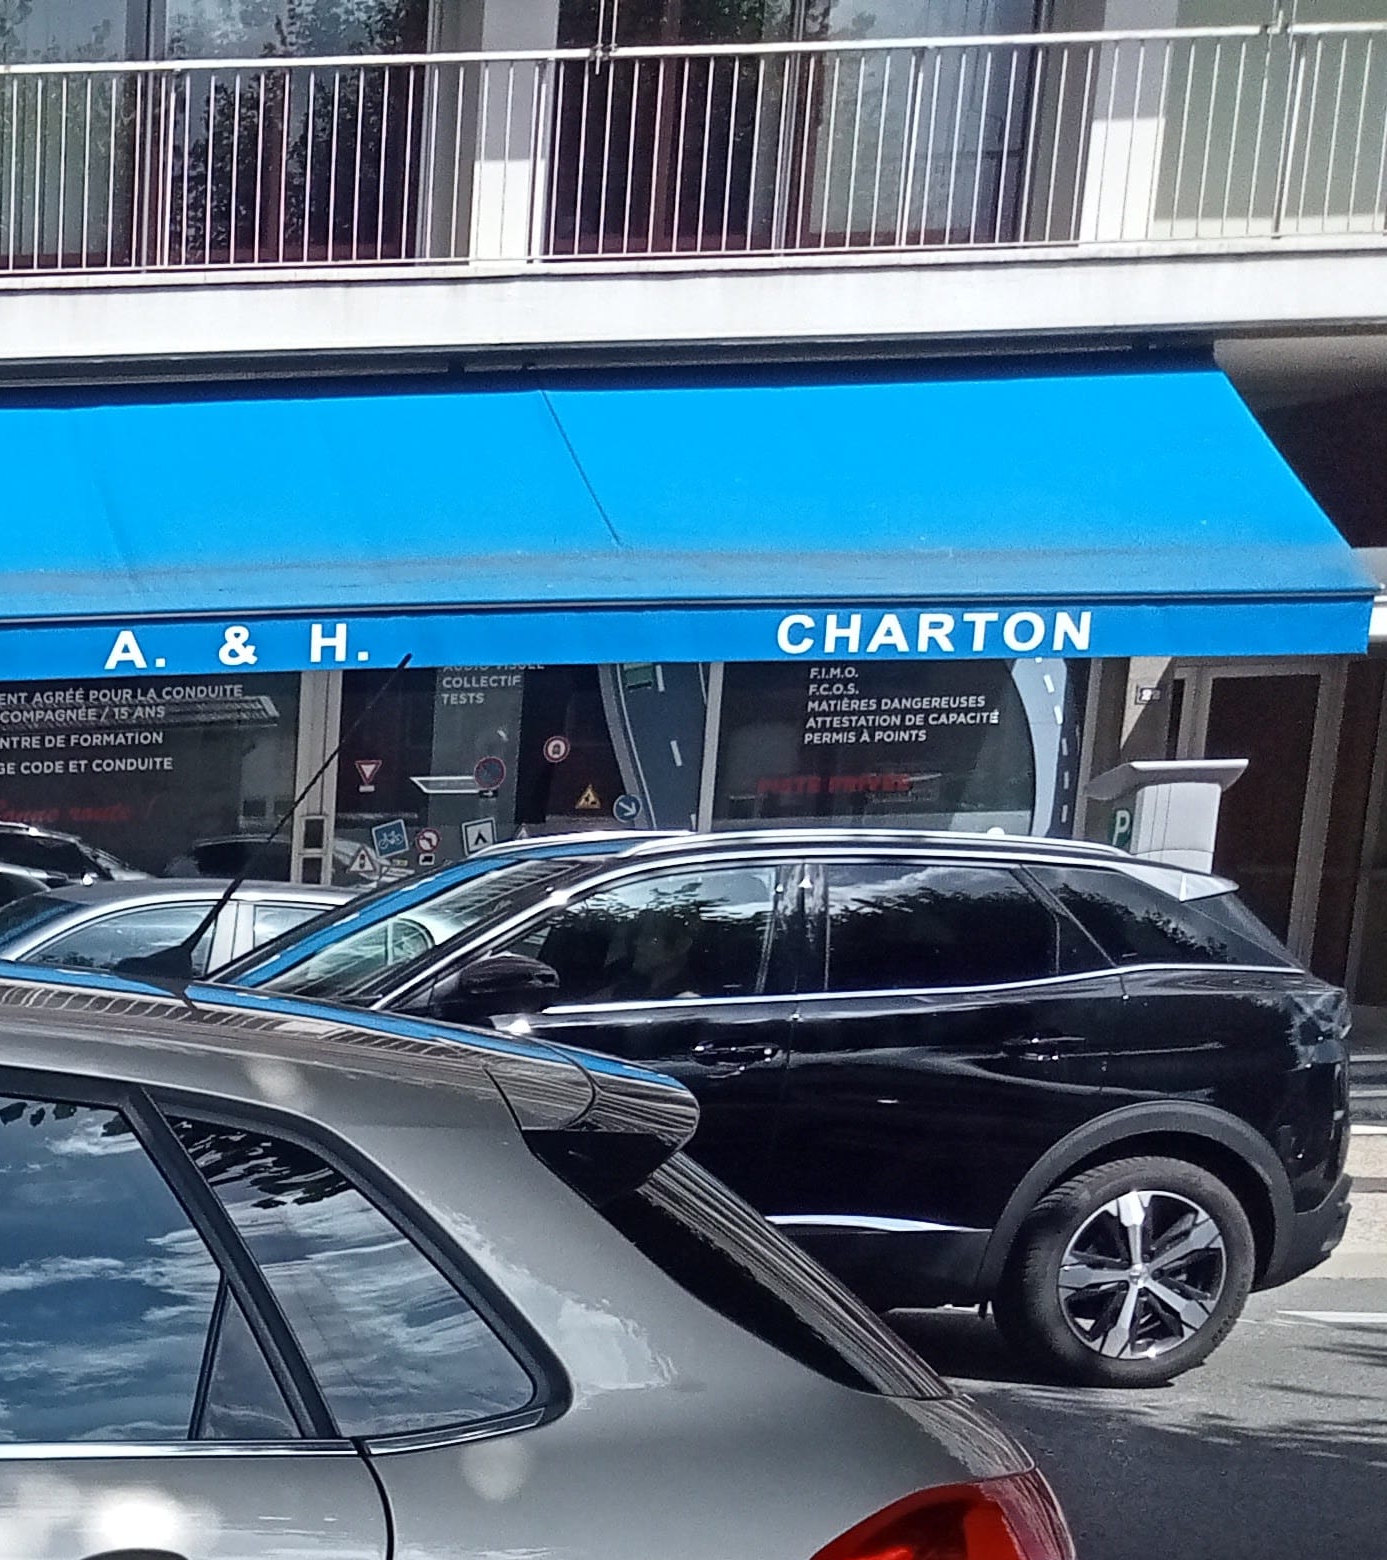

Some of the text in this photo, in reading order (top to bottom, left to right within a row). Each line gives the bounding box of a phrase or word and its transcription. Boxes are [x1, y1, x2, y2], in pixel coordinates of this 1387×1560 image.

[776, 610, 1092, 655] CHARTON
[104, 623, 370, 669] A. & H.
[442, 675, 522, 688] COLLECTIF
[809, 667, 859, 679] F.I.M.O.
[32, 688, 85, 705] AGRÉÉ
[89, 688, 133, 702] POUR
[137, 687, 157, 701] LA
[162, 684, 244, 700] CONDUITE
[808, 683, 860, 696] F.C.O.S.
[441, 692, 485, 705] TESTS
[807, 695, 986, 712] MATIÈRES DANGEREUSES
[114, 707, 129, 720] 15
[133, 705, 165, 720] ANS
[805, 709, 999, 729] ATTESTATION DE CAPACITÉ
[45, 735, 66, 748] DE
[70, 731, 164, 747] FORMATION
[804, 728, 927, 745] PERMIS À POINTS
[20, 760, 64, 775] CODE
[68, 759, 87, 773] ET
[92, 757, 173, 772] CONDUITE
